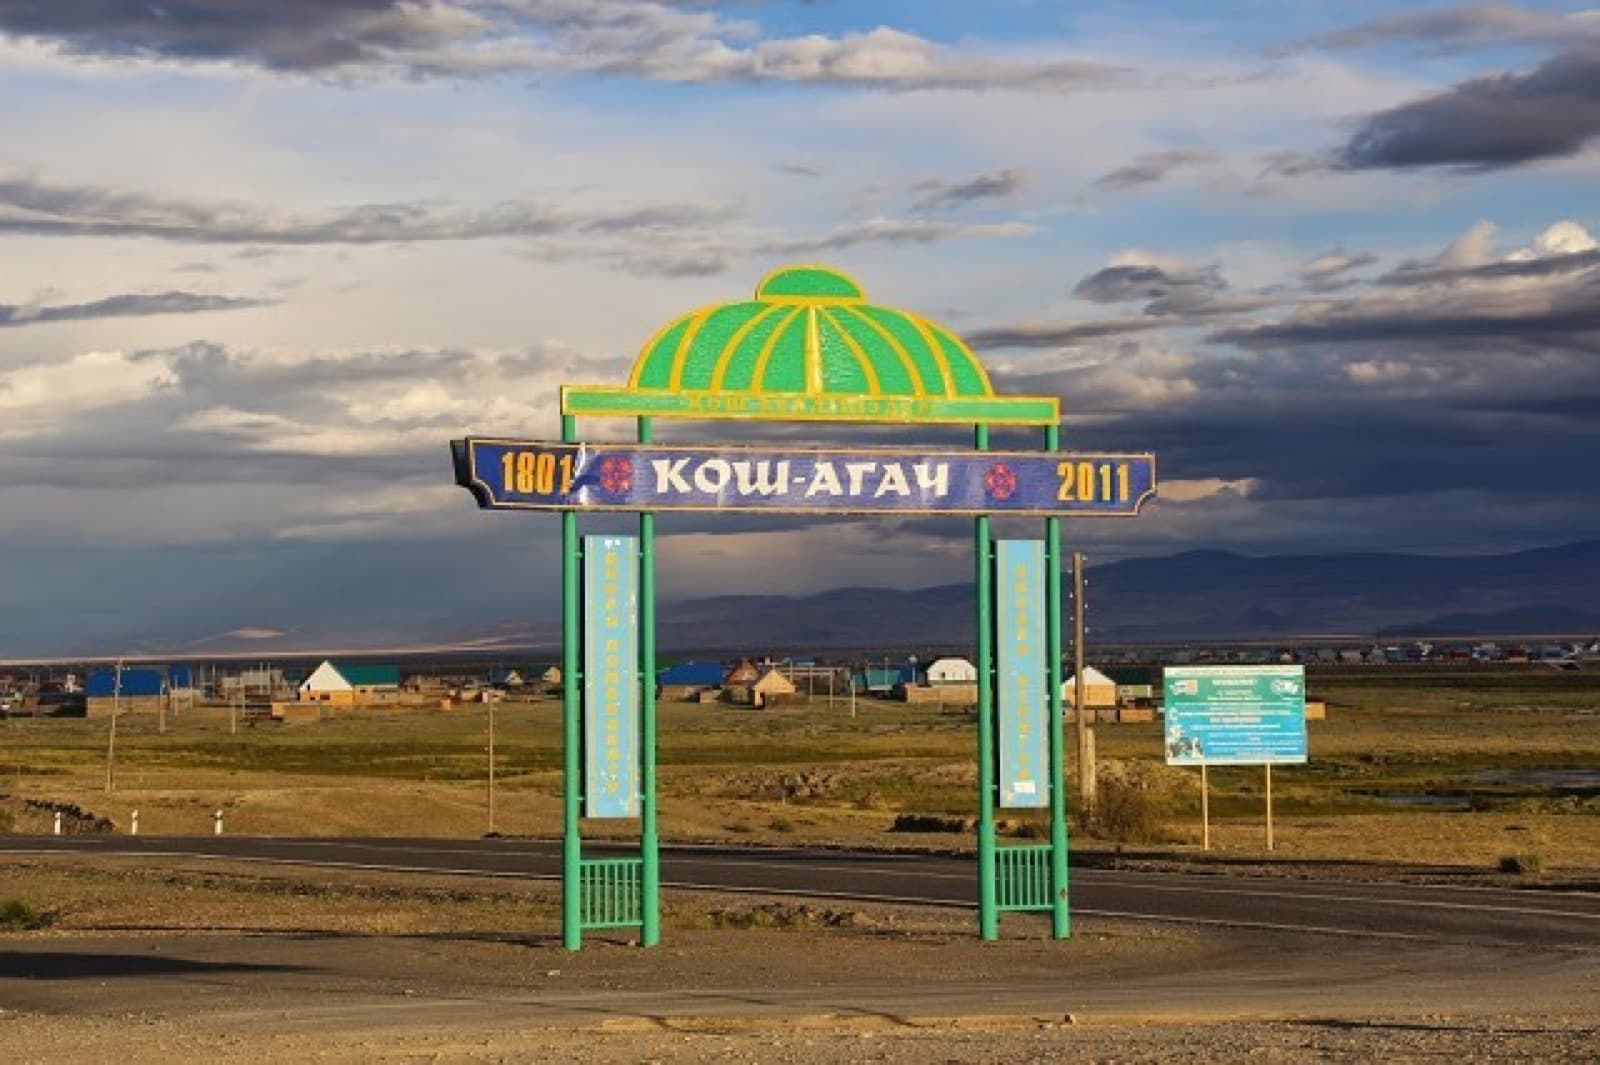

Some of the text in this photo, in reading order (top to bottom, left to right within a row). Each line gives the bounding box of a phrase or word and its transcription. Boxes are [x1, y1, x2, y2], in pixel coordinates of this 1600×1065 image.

[502, 452, 1129, 501] 1801 КОШ-АГАЧ 2011
